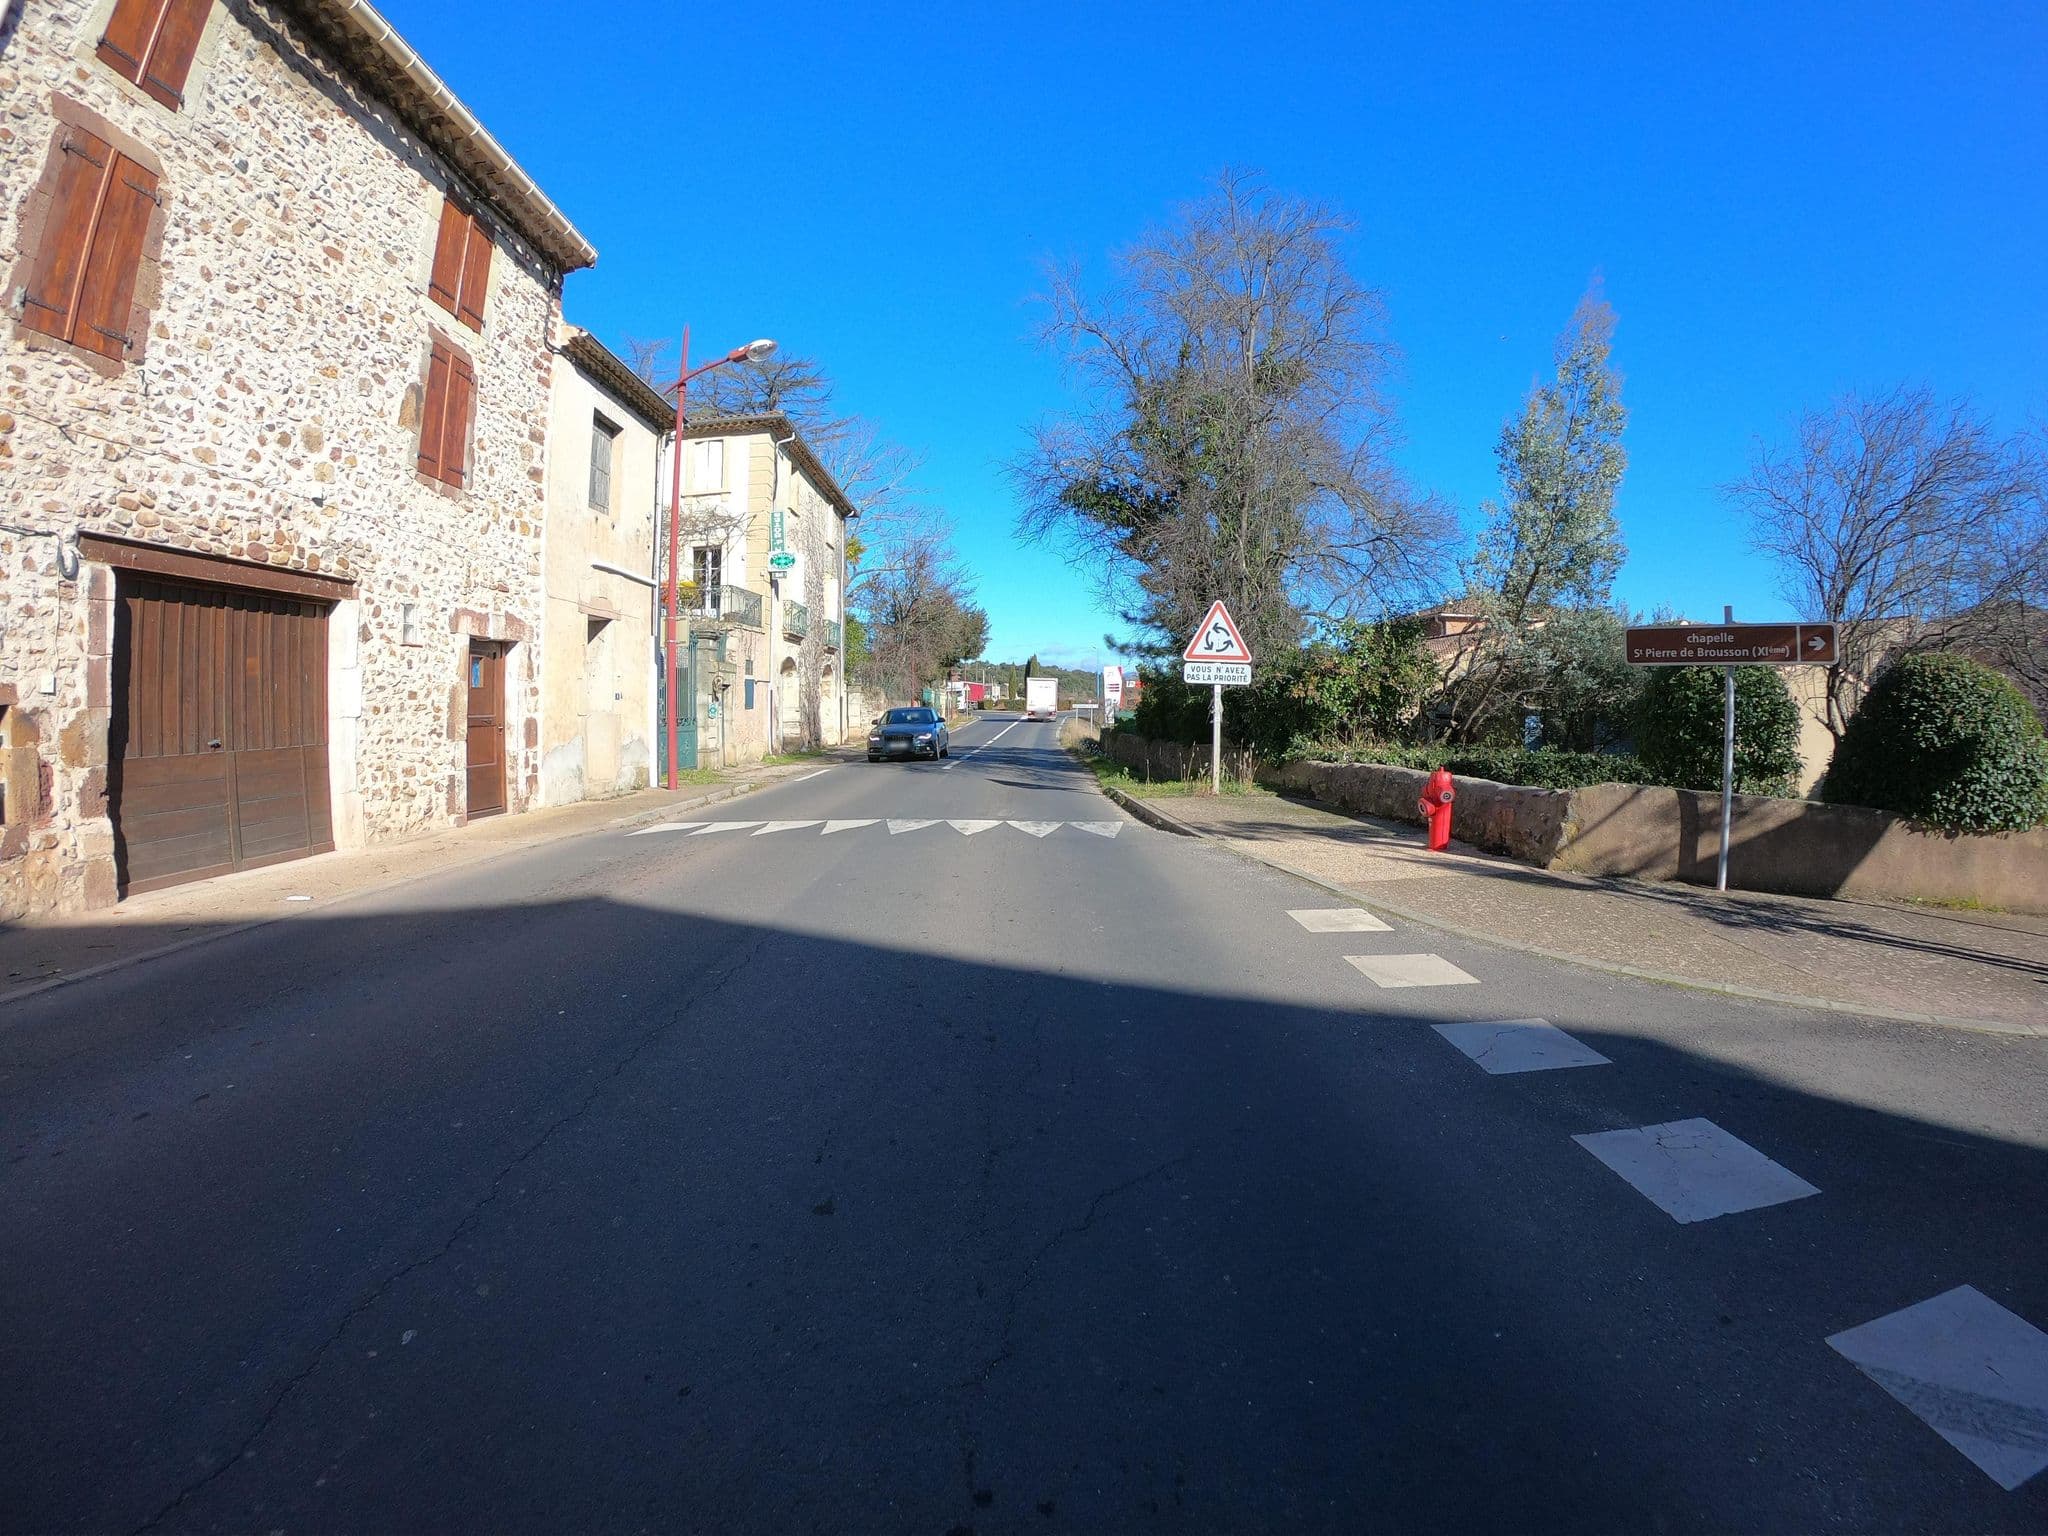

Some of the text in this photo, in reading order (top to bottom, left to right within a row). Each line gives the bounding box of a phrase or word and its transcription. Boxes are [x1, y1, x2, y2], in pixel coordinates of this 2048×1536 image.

[1686, 632, 1735, 645] chapelle
[1645, 648, 1677, 658] Pierre
[1680, 648, 1694, 657] de
[1697, 648, 1749, 657] Brousson
